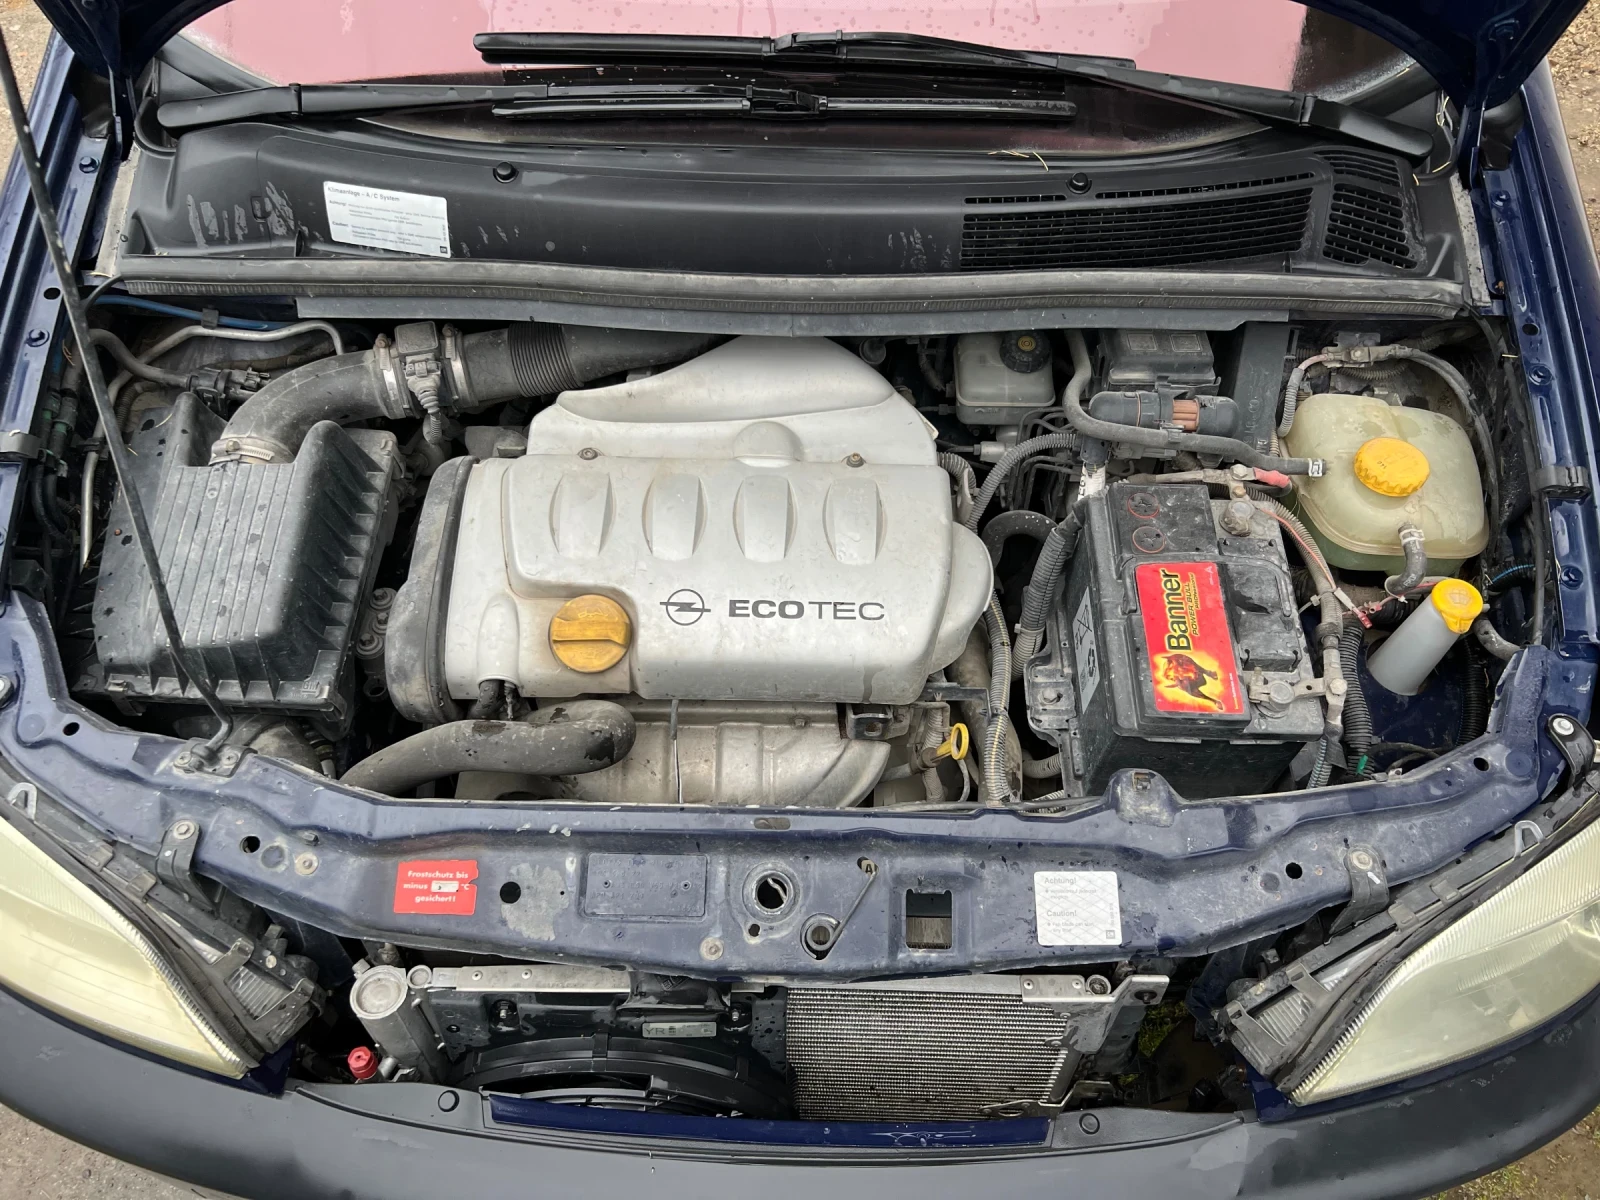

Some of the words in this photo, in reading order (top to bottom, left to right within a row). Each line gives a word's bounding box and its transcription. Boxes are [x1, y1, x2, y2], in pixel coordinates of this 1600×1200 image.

[380, 193, 400, 202] System
[1184, 582, 1193, 603] BULL
[728, 599, 885, 621] ECOTEC
[1161, 569, 1192, 651] Banner
[1188, 605, 1199, 636] POWER
[408, 870, 454, 878] Frostschutz
[456, 871, 468, 879] bis
[1044, 877, 1077, 885] Achtung!
[403, 882, 428, 890] minus
[414, 894, 456, 903] gesichert!
